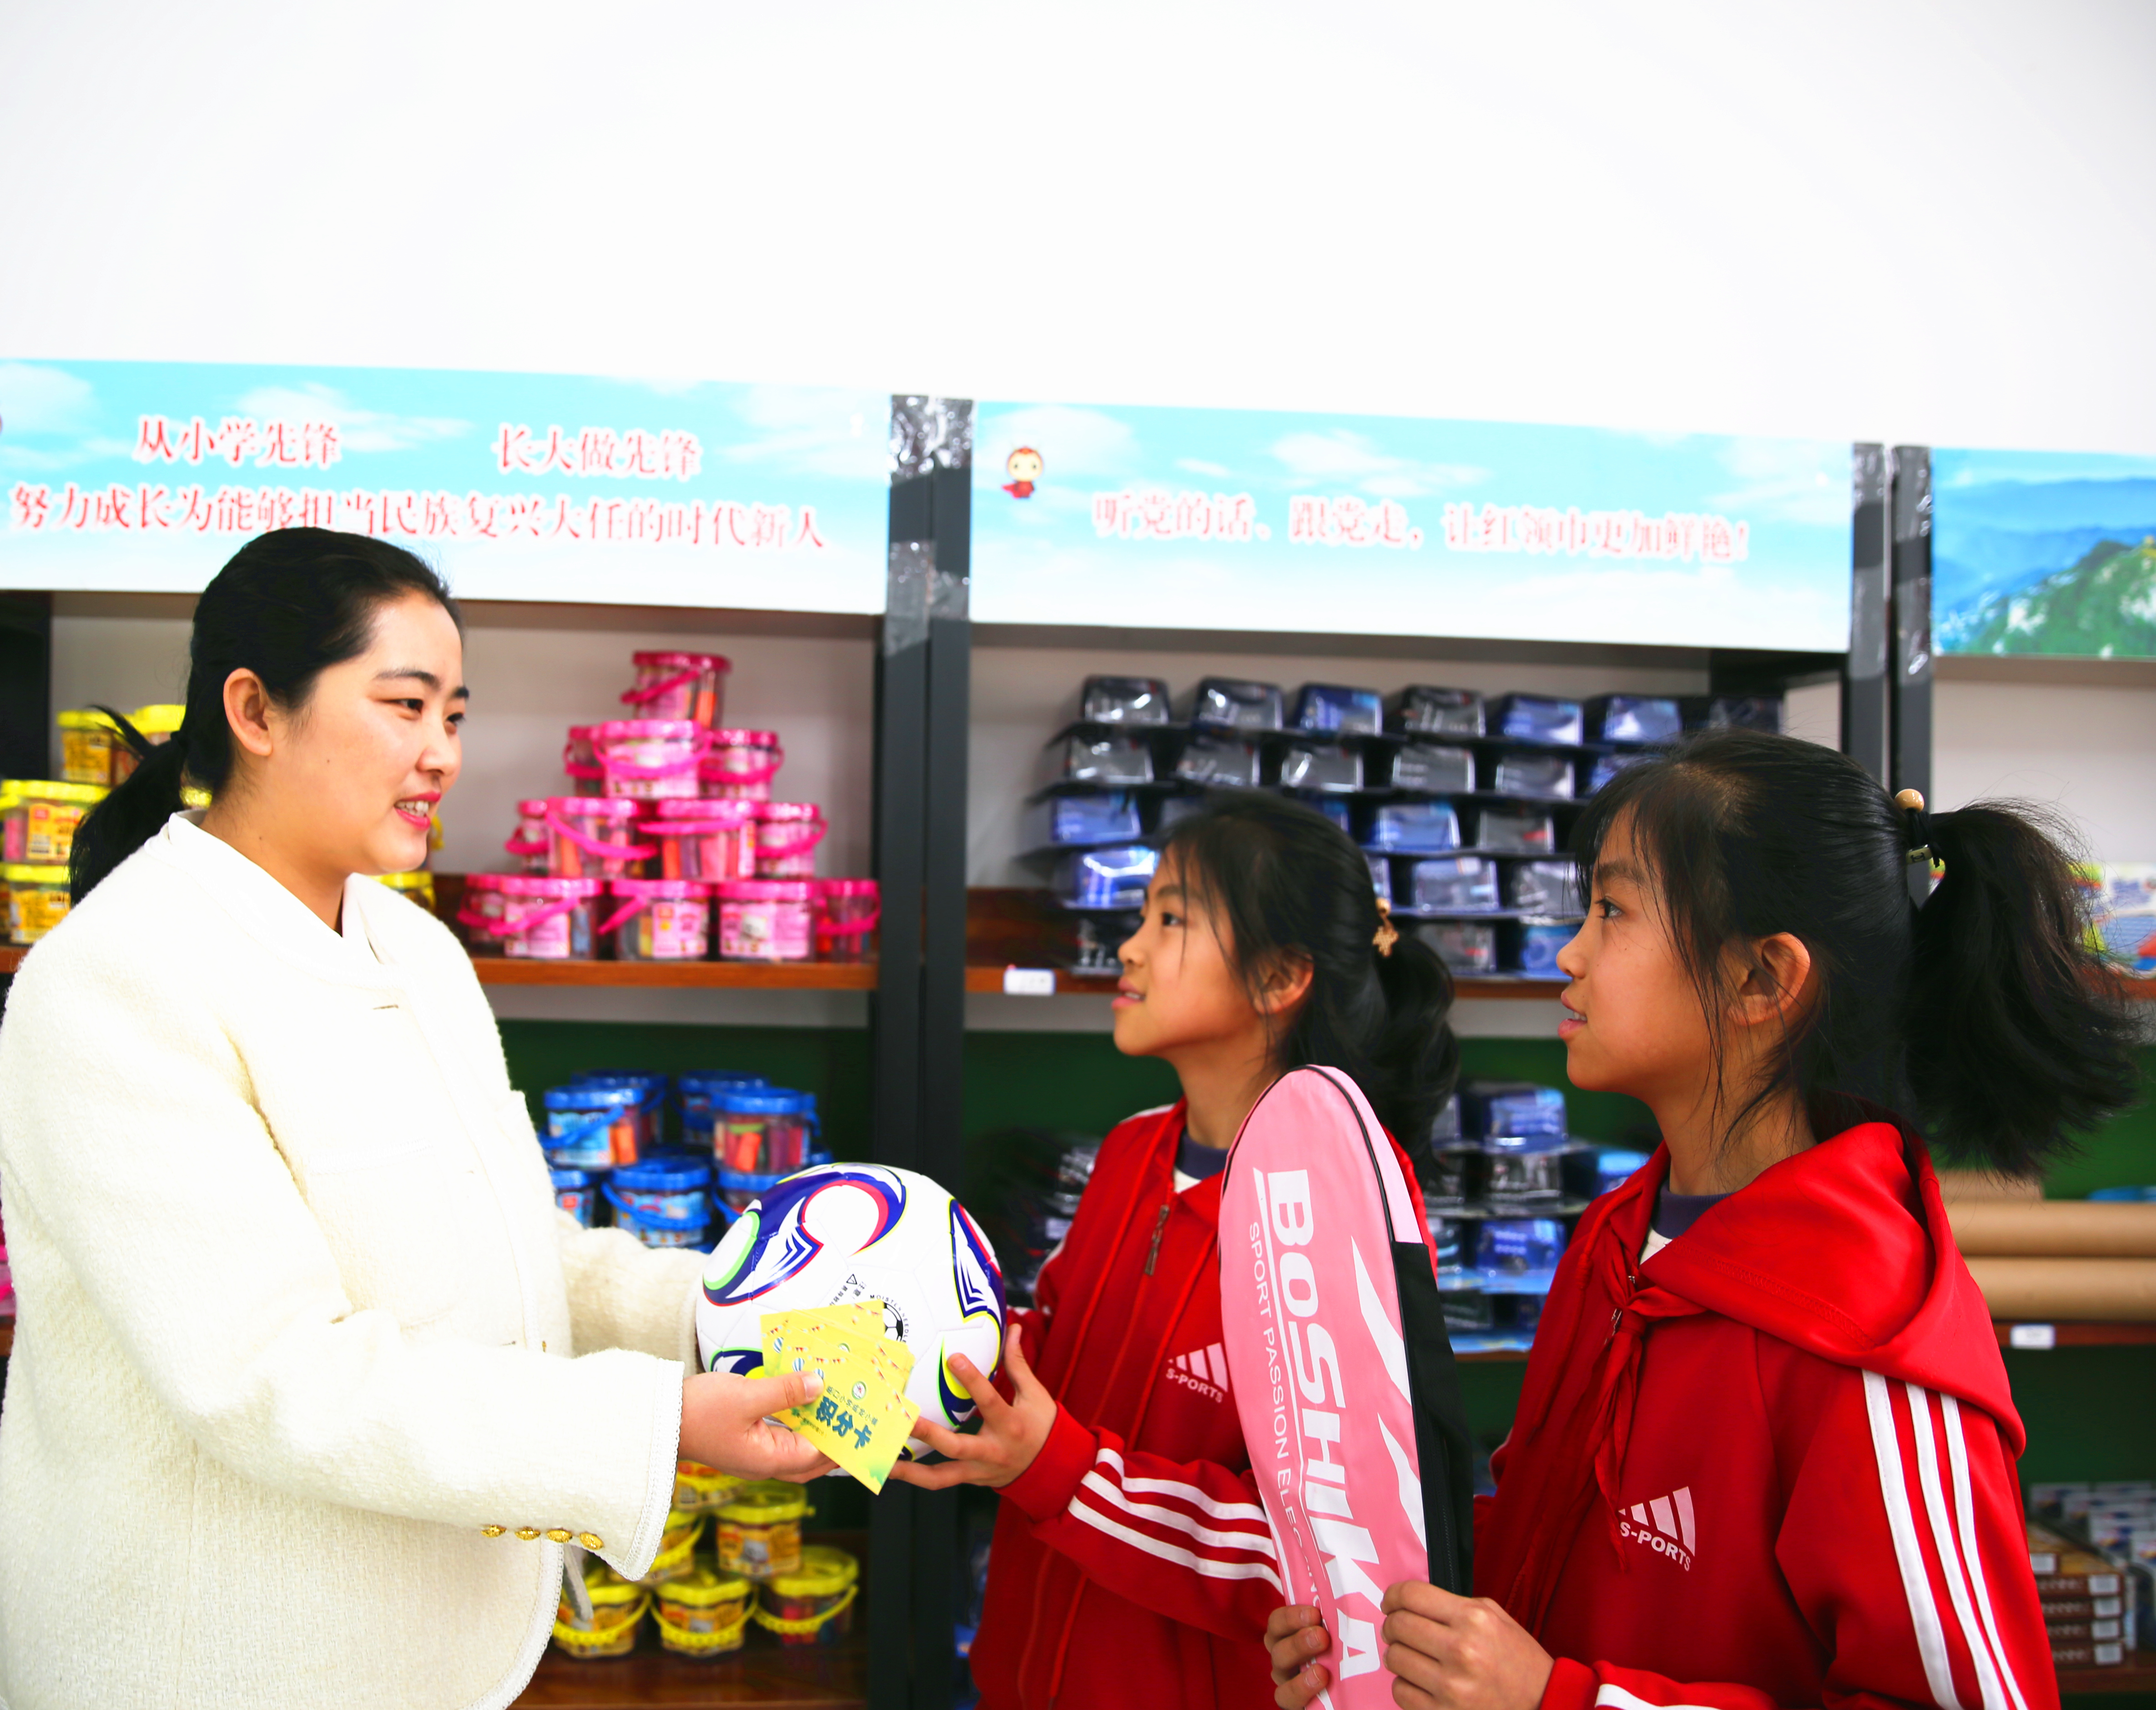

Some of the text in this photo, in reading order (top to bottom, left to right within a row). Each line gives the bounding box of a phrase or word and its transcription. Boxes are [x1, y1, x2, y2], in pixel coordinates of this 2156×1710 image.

[136, 417, 699, 476] 从小学先锋 长大做先锋
[1249, 1221, 1271, 1318] SPORT
[1263, 1327, 1289, 1459] PASSION
[1165, 1367, 1224, 1403] S-PORTS
[816, 1395, 872, 1450] 积分卡
[1267, 1169, 1384, 1681] BOSHIKA
[1620, 1521, 1691, 1572] S-PORTS
